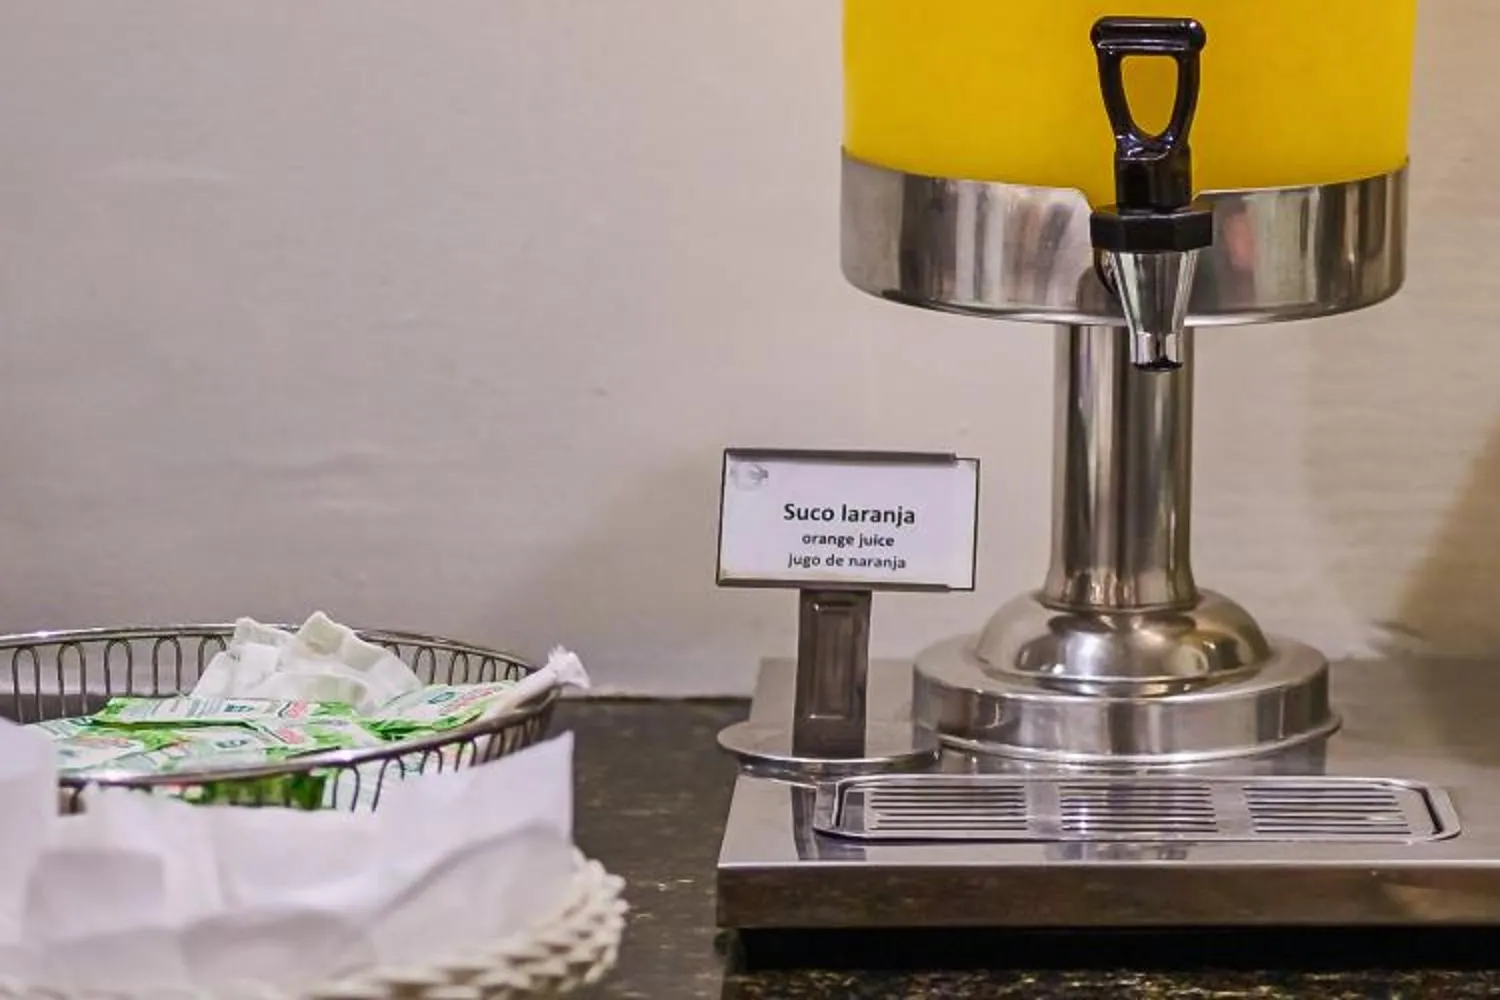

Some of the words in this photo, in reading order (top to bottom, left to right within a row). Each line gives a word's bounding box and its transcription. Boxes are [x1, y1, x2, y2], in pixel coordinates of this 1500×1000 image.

[784, 503, 835, 522] Suco
[841, 504, 916, 527] laranja
[802, 534, 855, 548] orange
[858, 533, 895, 548] juice
[826, 553, 844, 567] de
[848, 555, 907, 571] naranja
